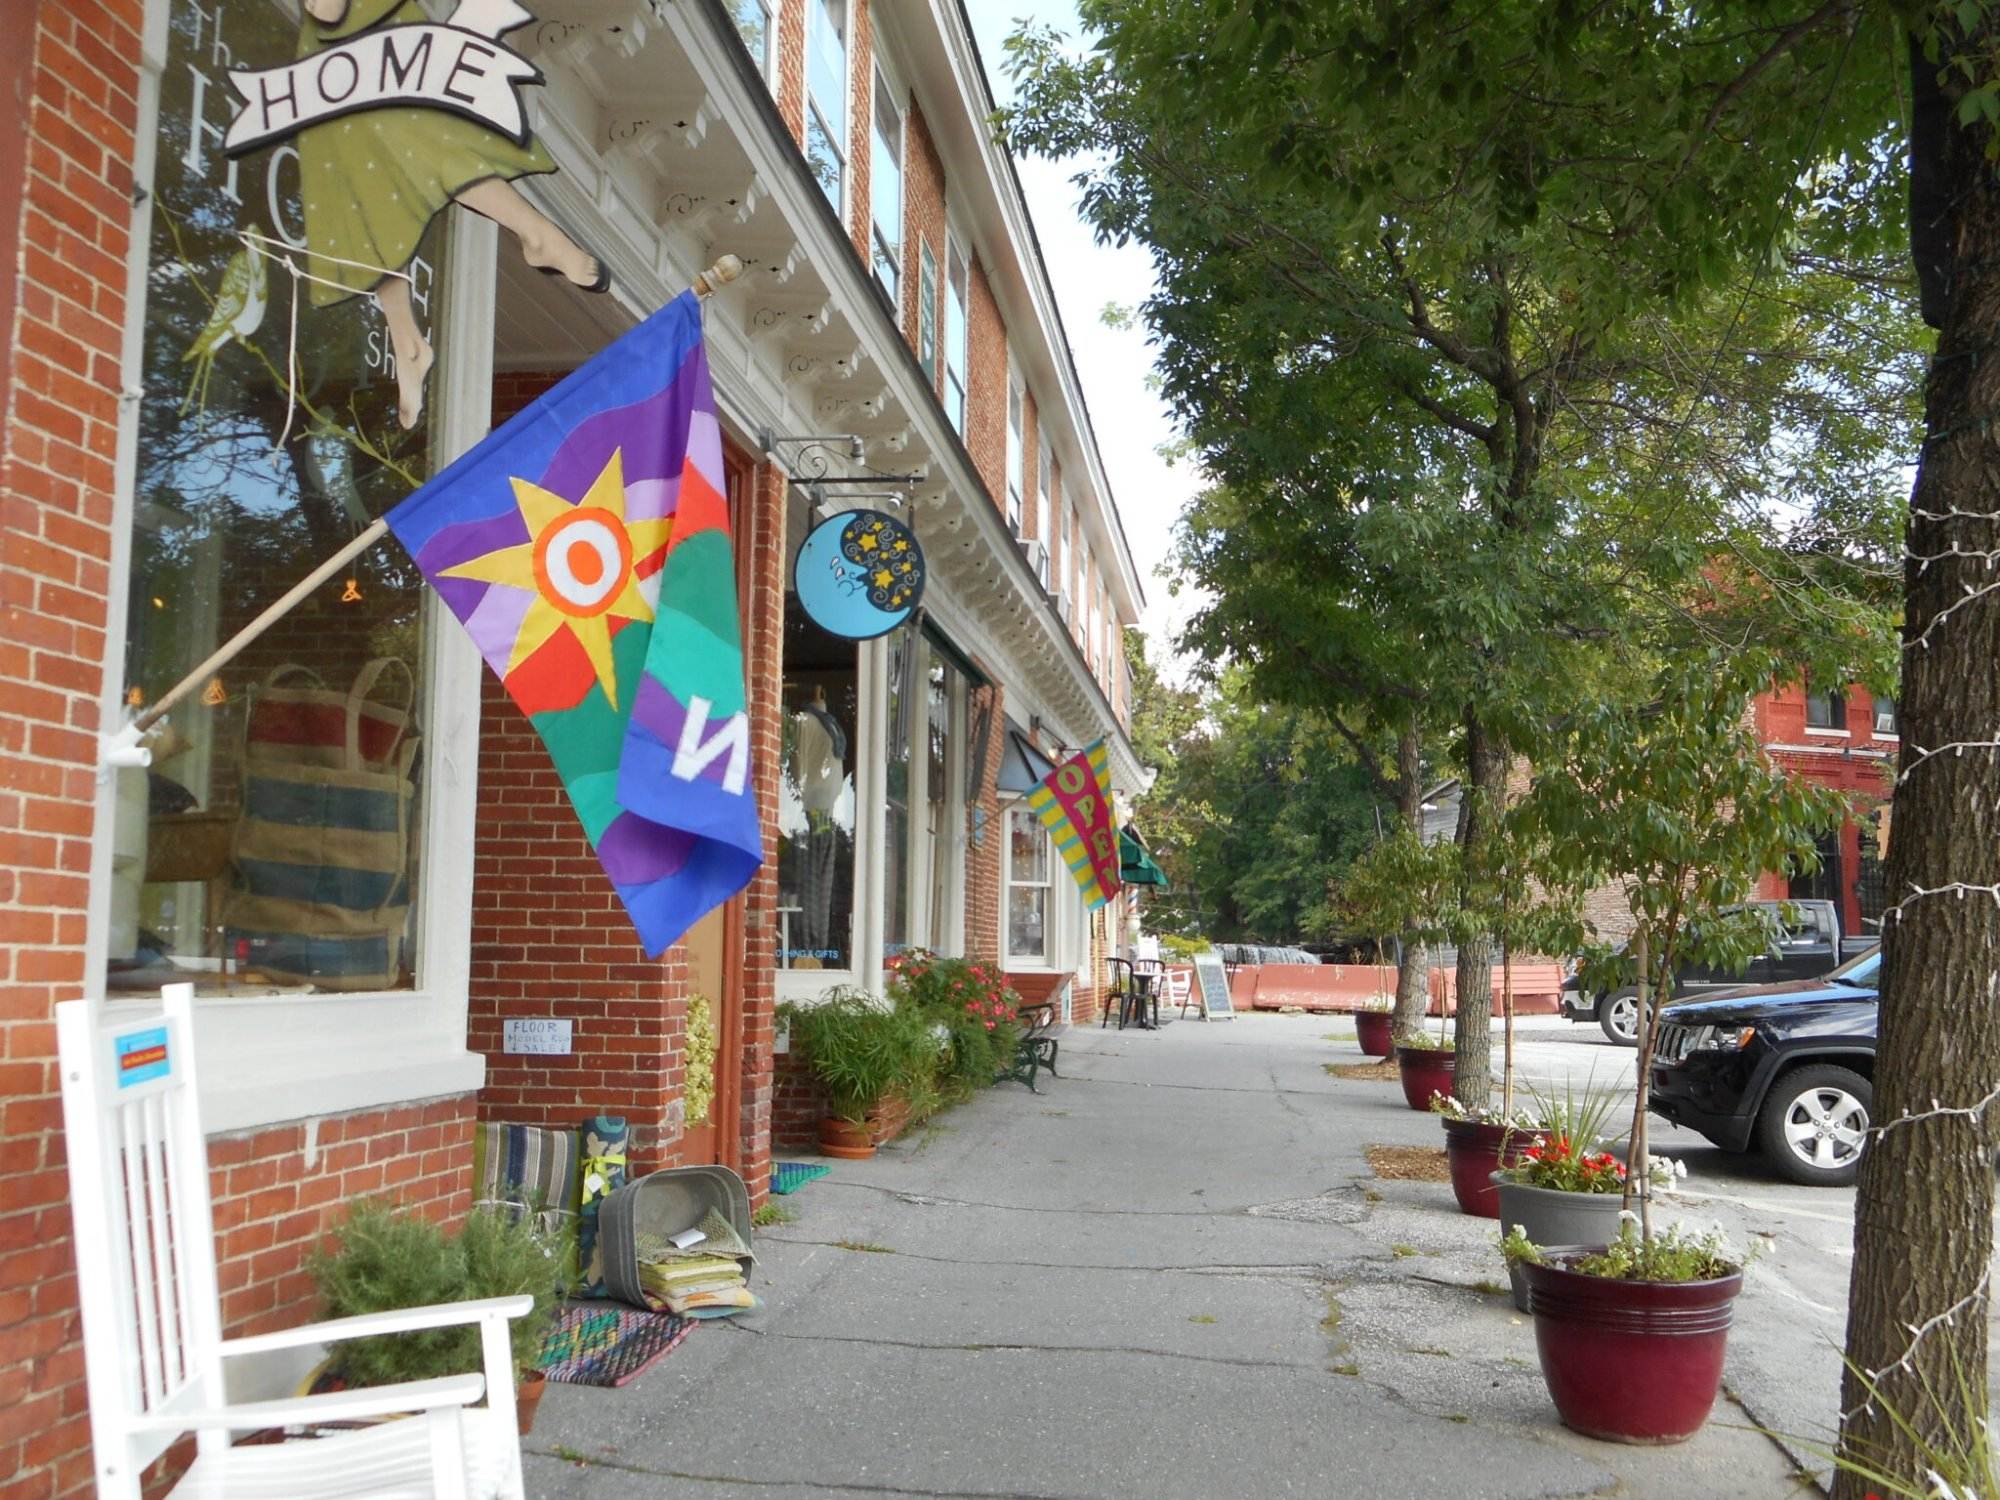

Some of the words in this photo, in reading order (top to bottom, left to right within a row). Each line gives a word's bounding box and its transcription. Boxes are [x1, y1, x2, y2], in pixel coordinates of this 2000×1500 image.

[259, 33, 496, 131] HOME
[1056, 763, 1118, 888] OPEN
[815, 949, 840, 959] GIFTS
[513, 1022, 557, 1033] FLOOR
[523, 1043, 556, 1052] SALE
